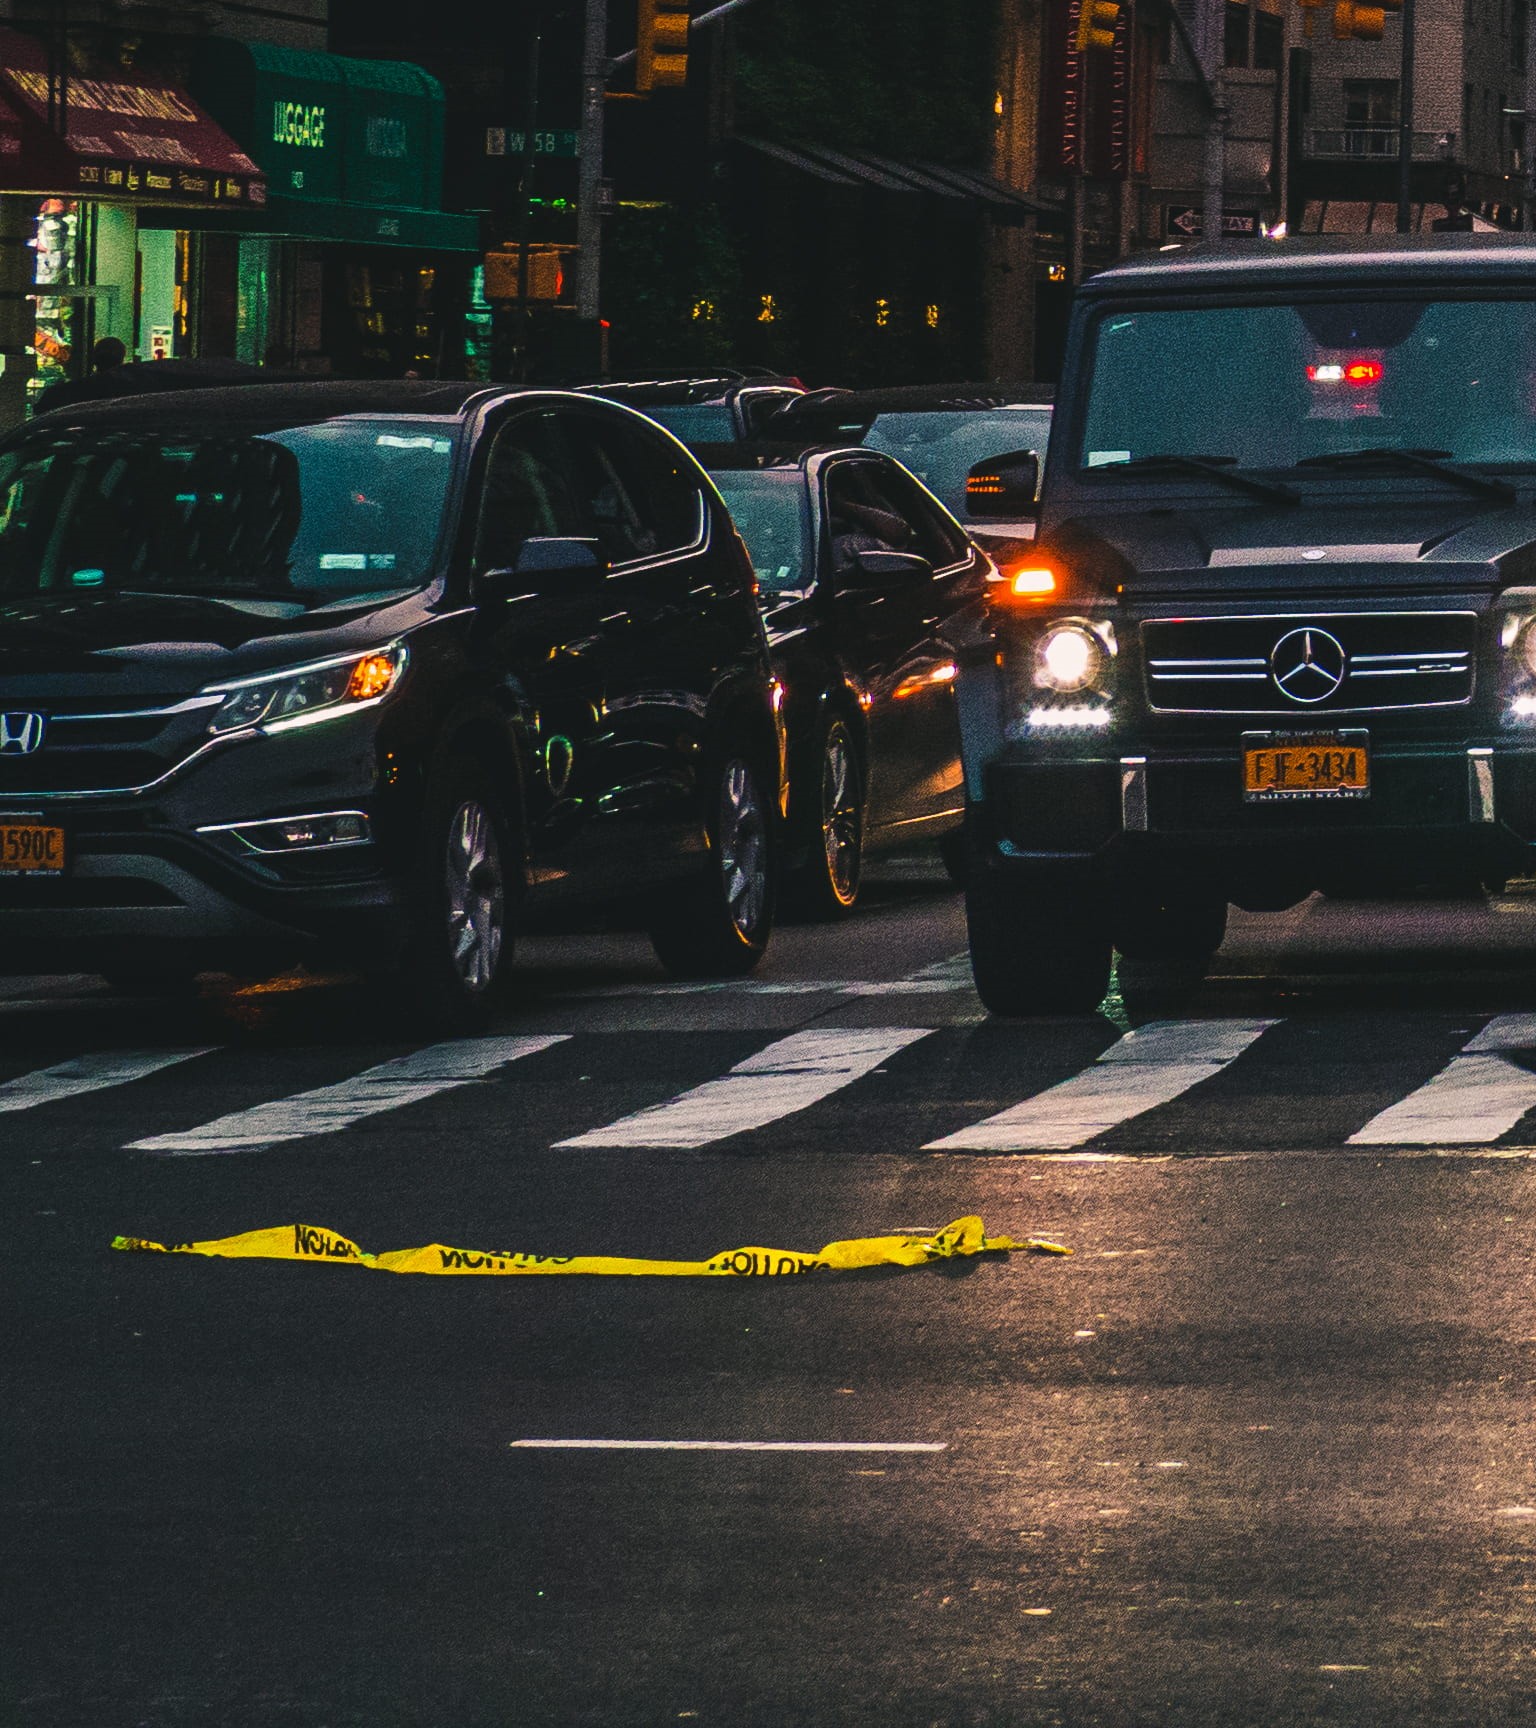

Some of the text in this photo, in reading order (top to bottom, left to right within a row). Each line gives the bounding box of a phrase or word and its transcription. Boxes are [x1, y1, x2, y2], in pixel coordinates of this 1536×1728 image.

[273, 101, 326, 148] LUGGAGE
[510, 133, 525, 151] W
[535, 133, 555, 152] 58
[1062, 90, 1077, 165] ITALIAN
